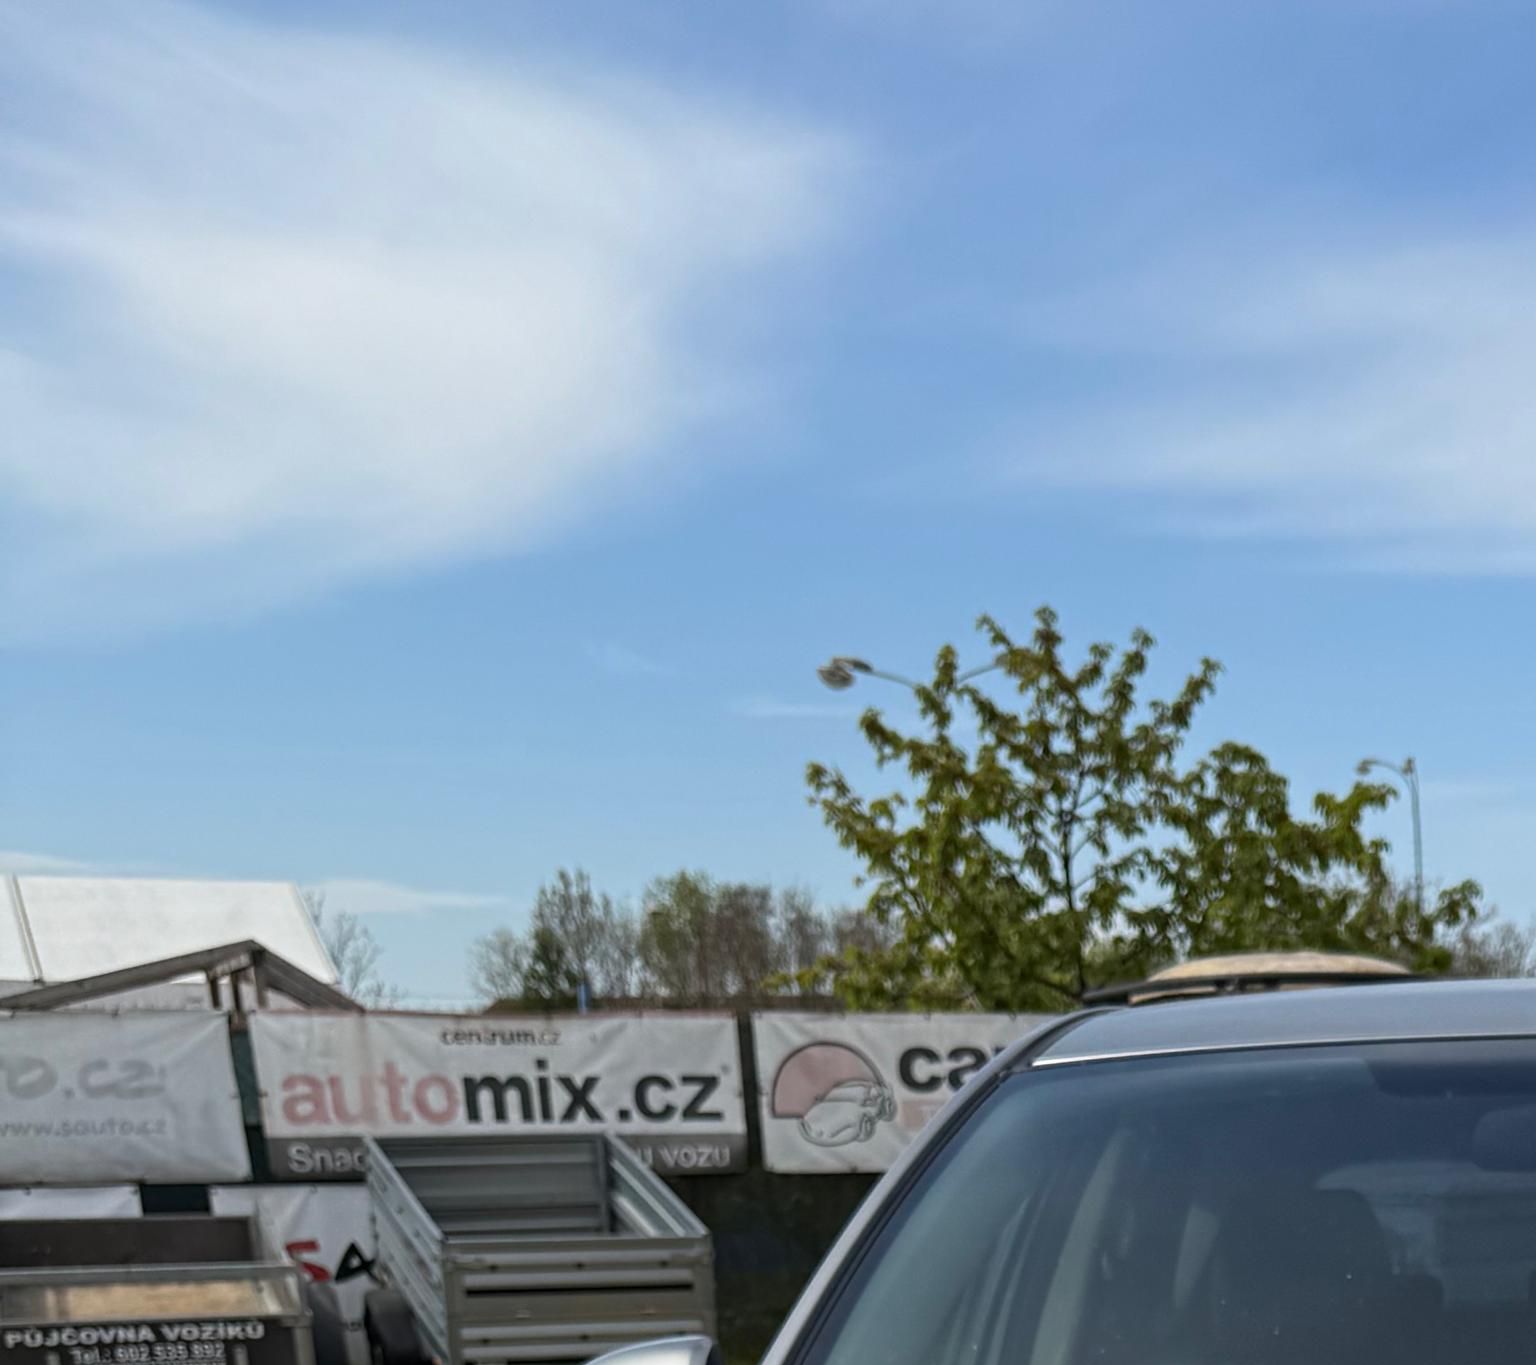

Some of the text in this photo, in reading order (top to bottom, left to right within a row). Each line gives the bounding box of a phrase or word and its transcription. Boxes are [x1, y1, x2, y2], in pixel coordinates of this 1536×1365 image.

[0, 1056, 167, 1100] o.cz
[280, 1057, 725, 1125] automix.cz
[898, 1046, 1007, 1092] ca
[657, 1143, 731, 1169] vozu
[114, 1343, 151, 1363] 602
[152, 1341, 189, 1361] 535
